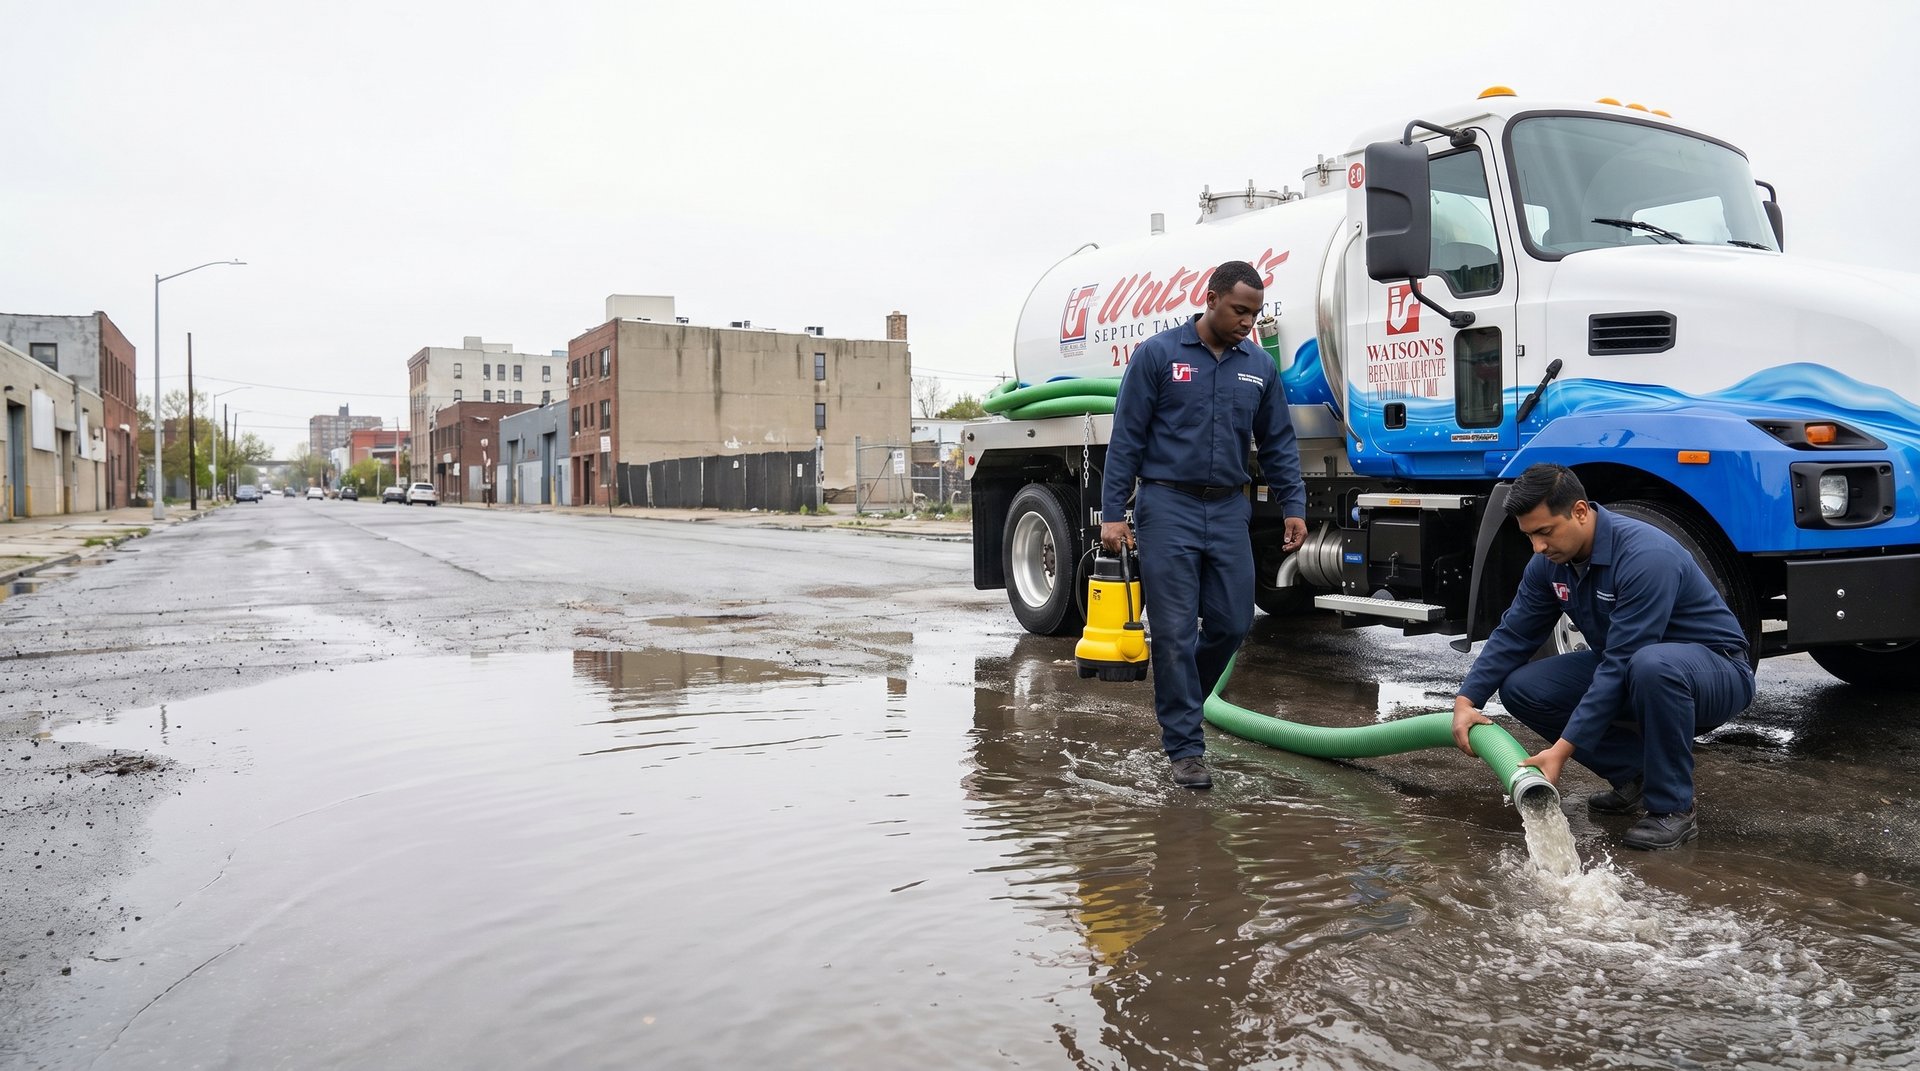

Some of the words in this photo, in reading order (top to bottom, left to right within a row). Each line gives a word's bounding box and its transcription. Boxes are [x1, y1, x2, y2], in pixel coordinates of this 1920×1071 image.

[1097, 247, 1290, 325] Watso's
[1094, 322, 1145, 344] SEPTIC
[1153, 314, 1192, 334] TAN
[1111, 341, 1141, 367] 21
[1366, 337, 1444, 362] WATSON'S
